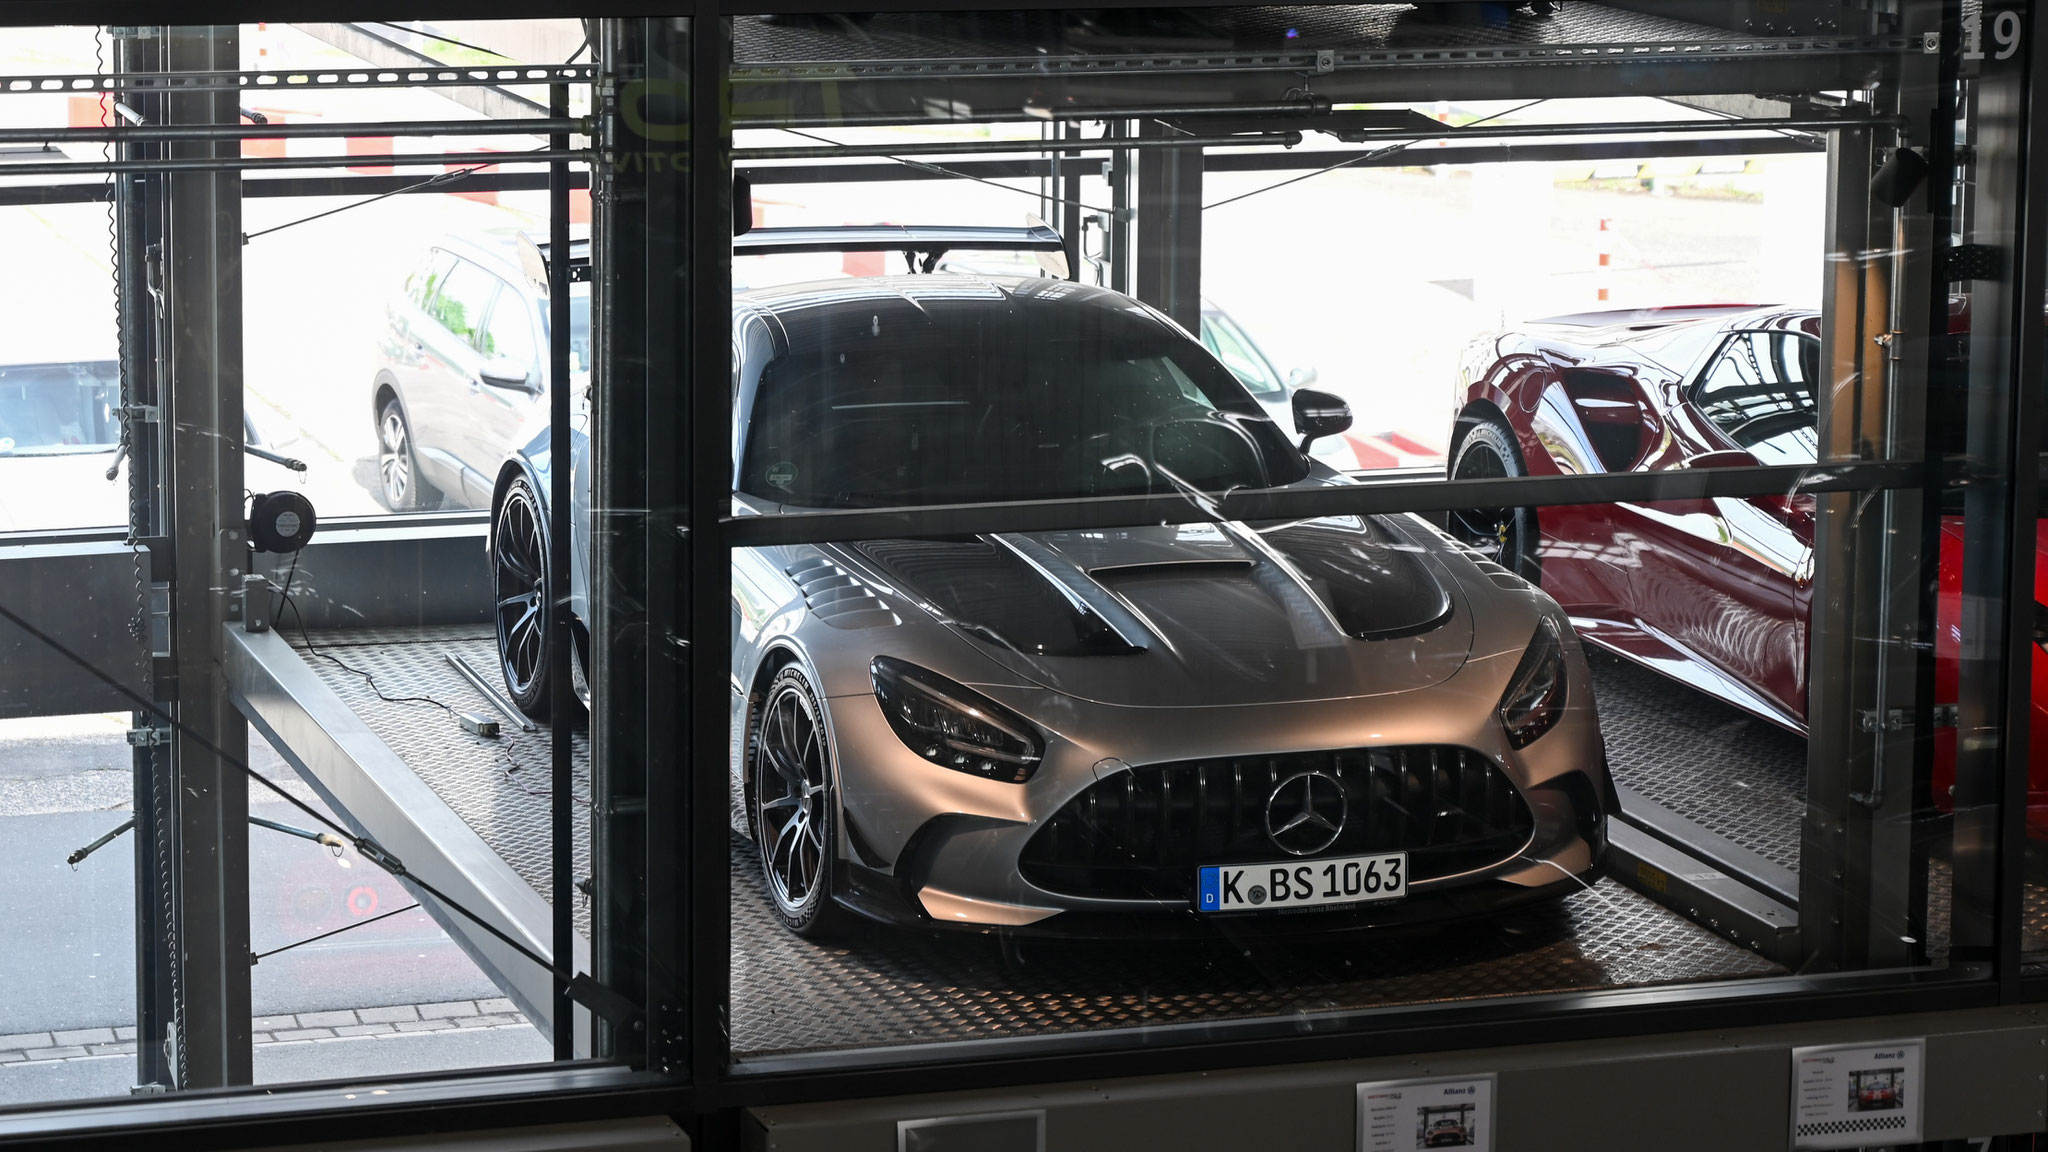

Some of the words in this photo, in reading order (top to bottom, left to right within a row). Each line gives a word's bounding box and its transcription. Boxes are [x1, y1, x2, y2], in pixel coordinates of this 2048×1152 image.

[1961, 10, 2021, 60] 19
[784, 669, 808, 689] MICHELIN
[1223, 870, 1245, 904] K
[1270, 866, 1314, 902] BS
[1323, 858, 1401, 898] 1063
[1205, 893, 1215, 904] D
[1874, 1052, 1896, 1060] Allianz
[1443, 1087, 1466, 1096] Allianz
